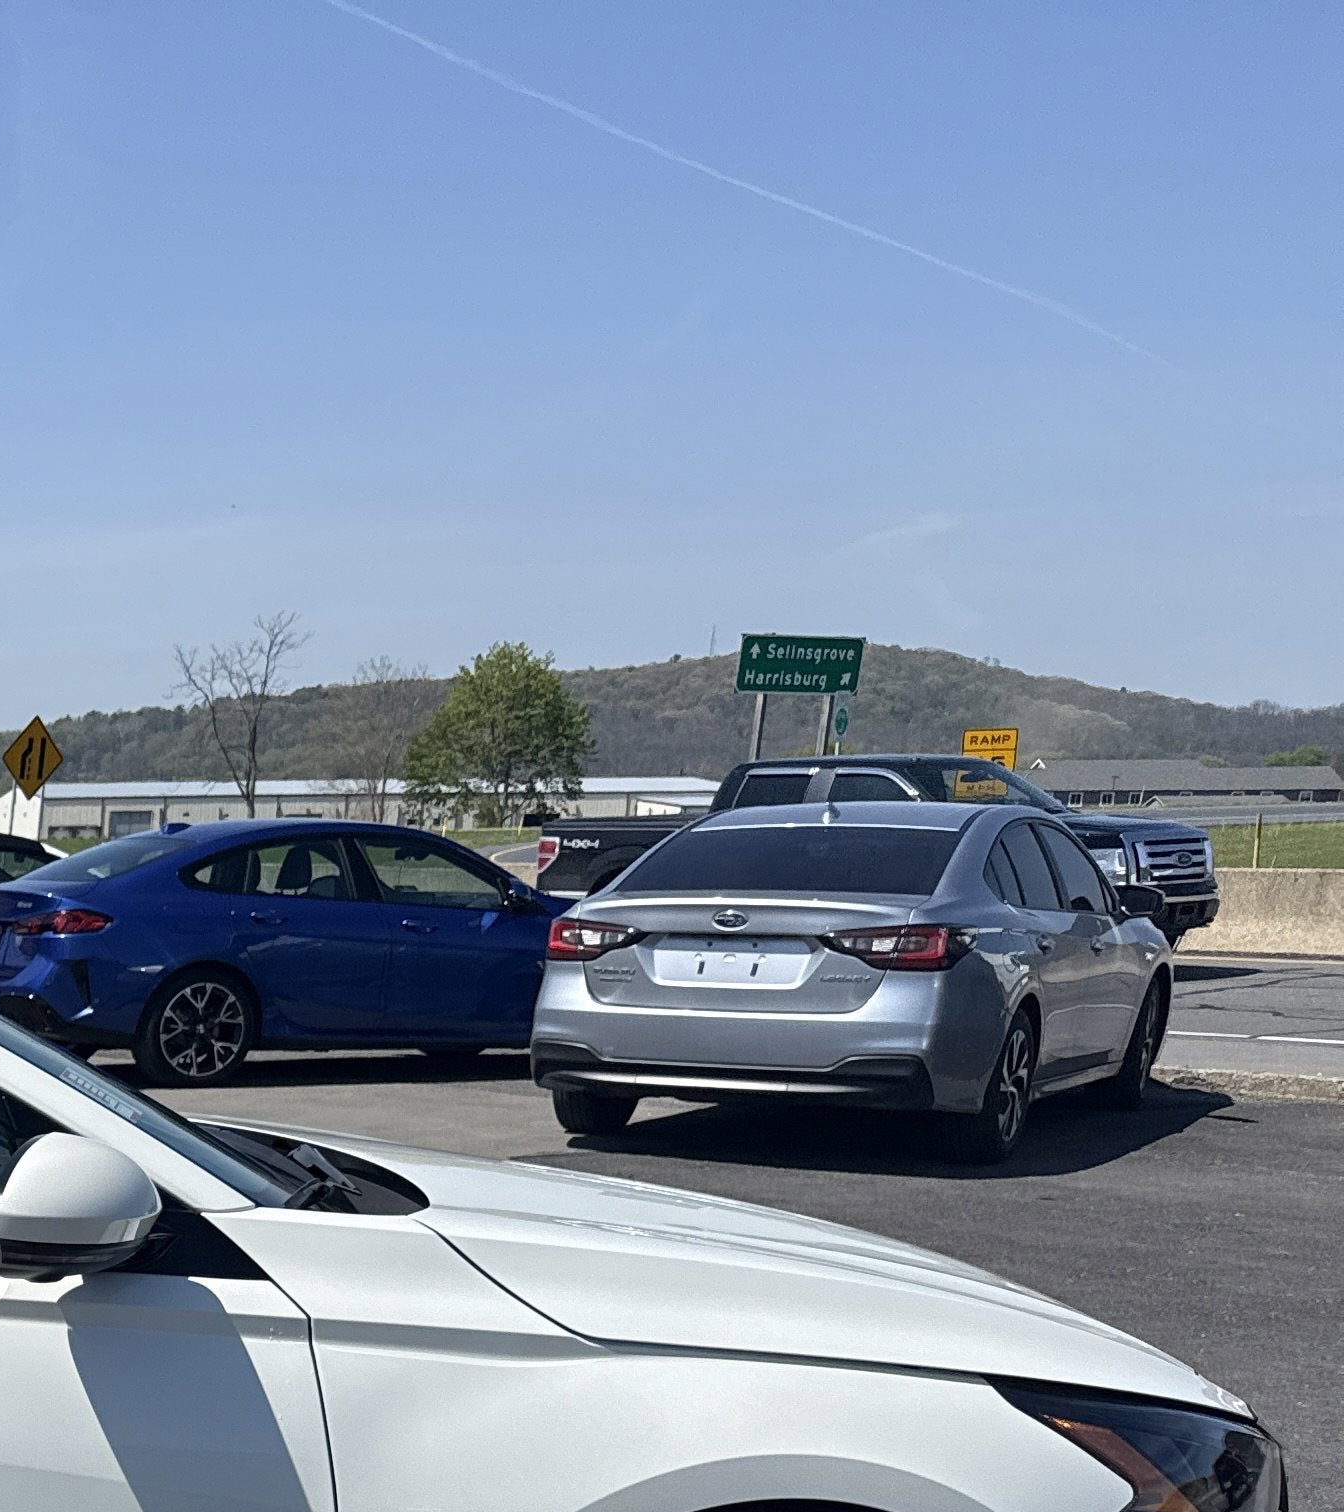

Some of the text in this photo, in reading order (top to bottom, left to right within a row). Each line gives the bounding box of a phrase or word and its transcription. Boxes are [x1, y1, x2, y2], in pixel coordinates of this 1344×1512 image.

[766, 643, 856, 665] Selinsgrove
[744, 669, 827, 691] Harrisburg
[969, 734, 1012, 746] RAMP
